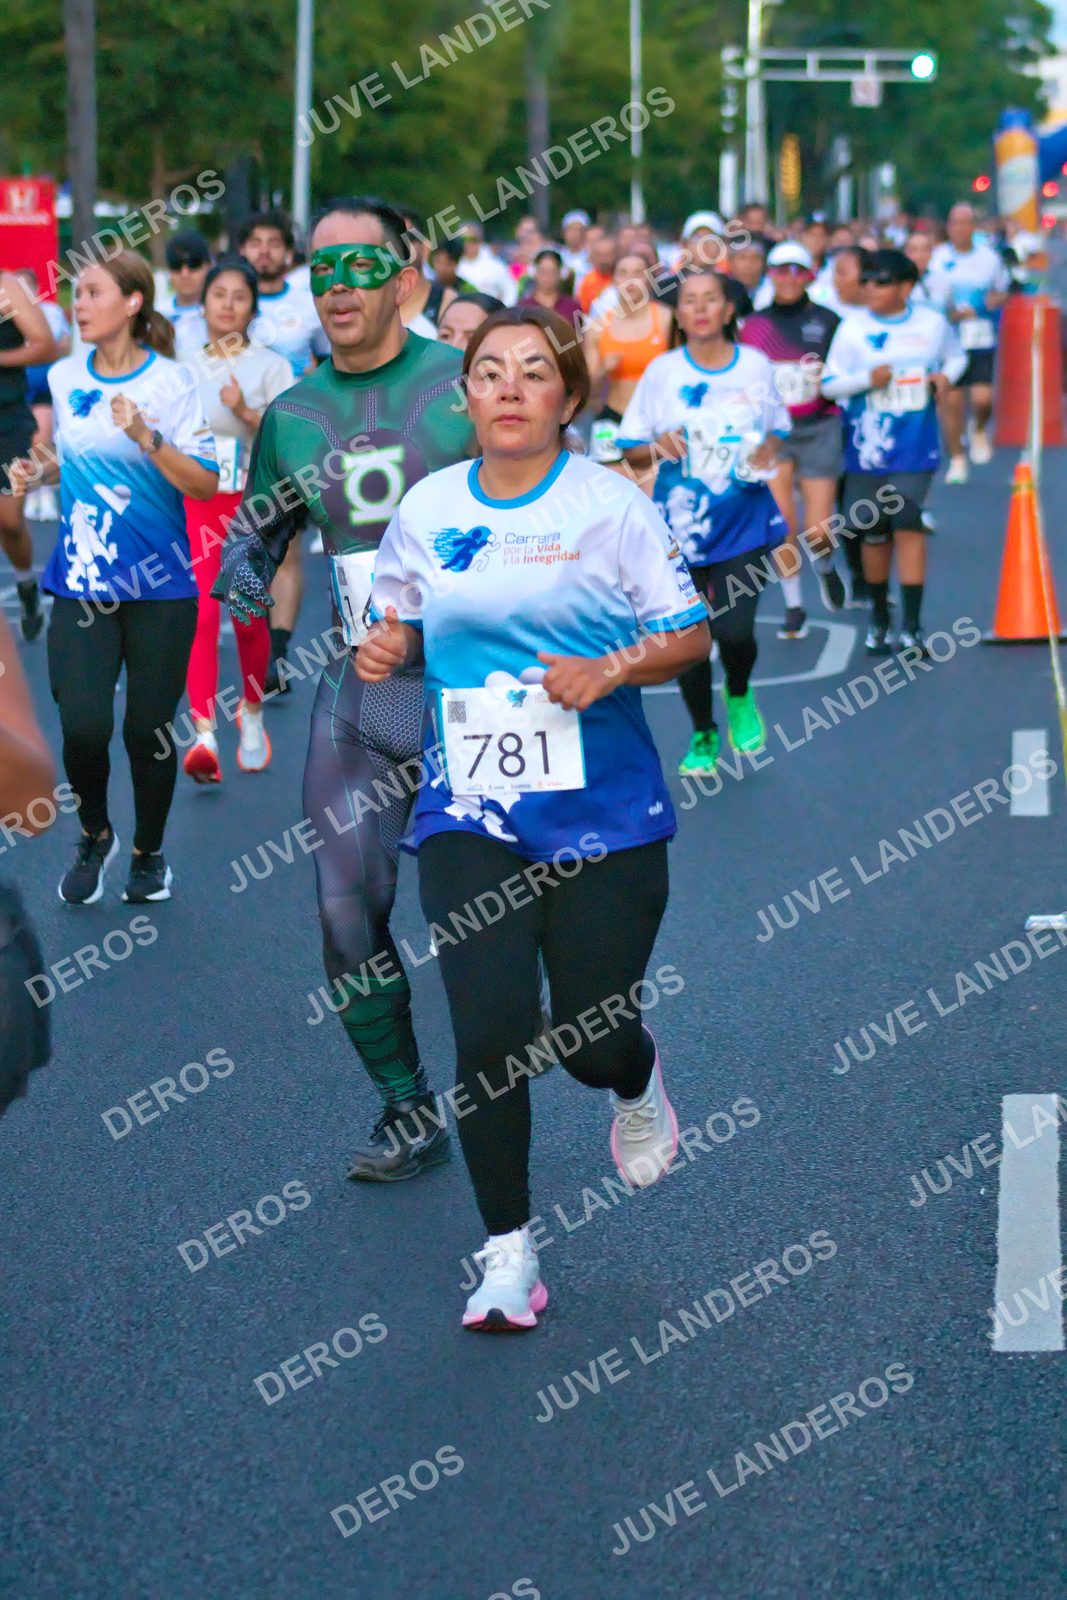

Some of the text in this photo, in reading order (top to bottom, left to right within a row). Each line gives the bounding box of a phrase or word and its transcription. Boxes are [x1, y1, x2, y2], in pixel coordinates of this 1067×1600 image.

[504, 532, 561, 544] Carrera
[537, 543, 561, 553] Vida
[463, 730, 550, 779] 781
